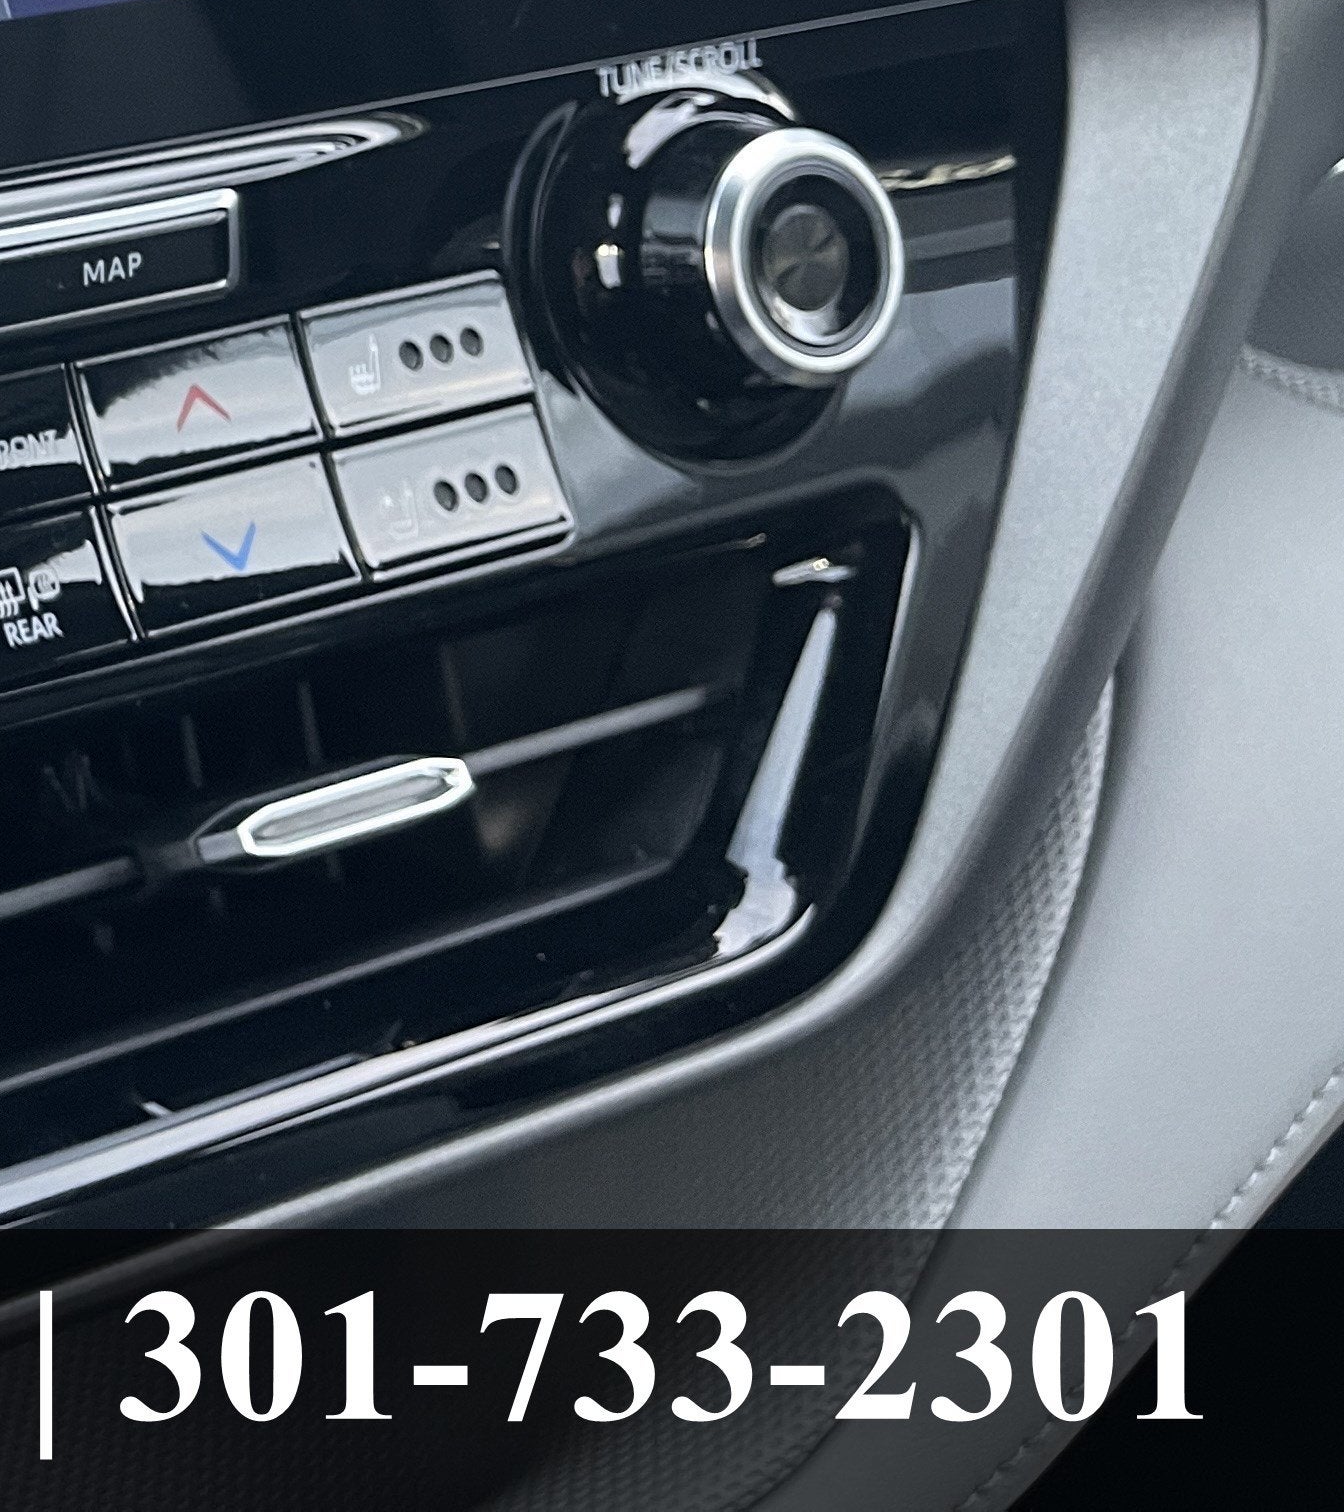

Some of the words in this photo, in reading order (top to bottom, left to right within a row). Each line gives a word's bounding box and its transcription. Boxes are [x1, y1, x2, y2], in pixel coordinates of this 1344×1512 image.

[596, 37, 764, 98] TUNE/SCROLL
[82, 249, 143, 287] MAP
[2, 611, 64, 650] REAR
